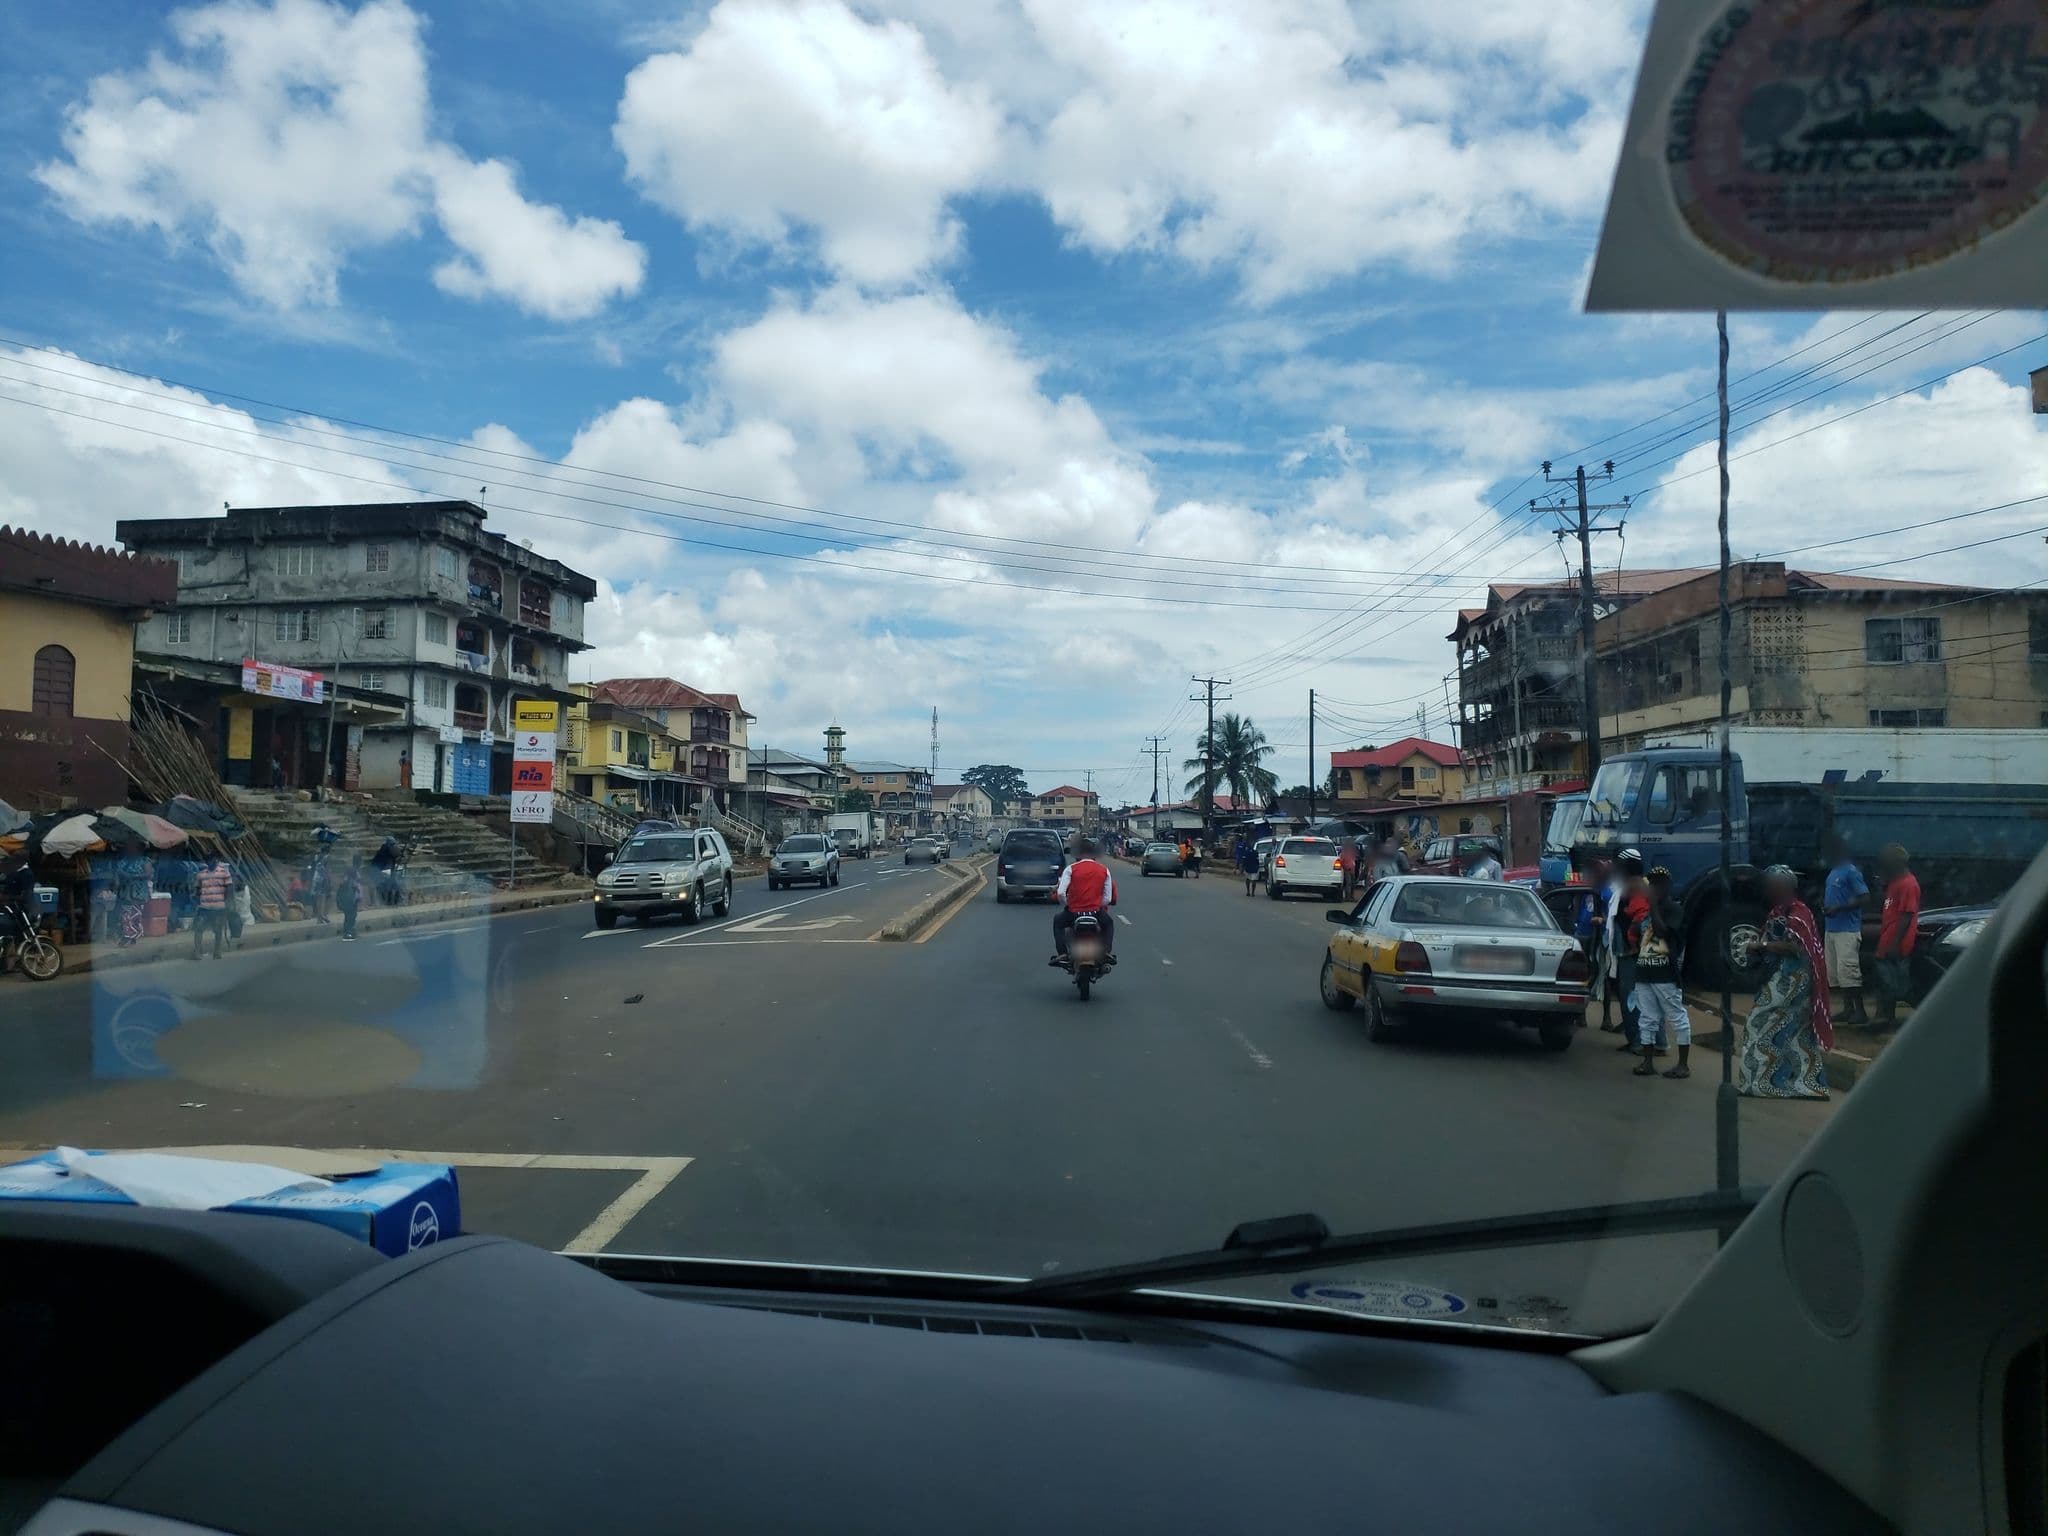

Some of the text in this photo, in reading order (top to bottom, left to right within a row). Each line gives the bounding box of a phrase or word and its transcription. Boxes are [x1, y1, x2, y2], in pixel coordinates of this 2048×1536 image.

[1767, 142, 1982, 175] RITCORP
[518, 767, 543, 781] Ria
[512, 806, 545, 814] AFRO
